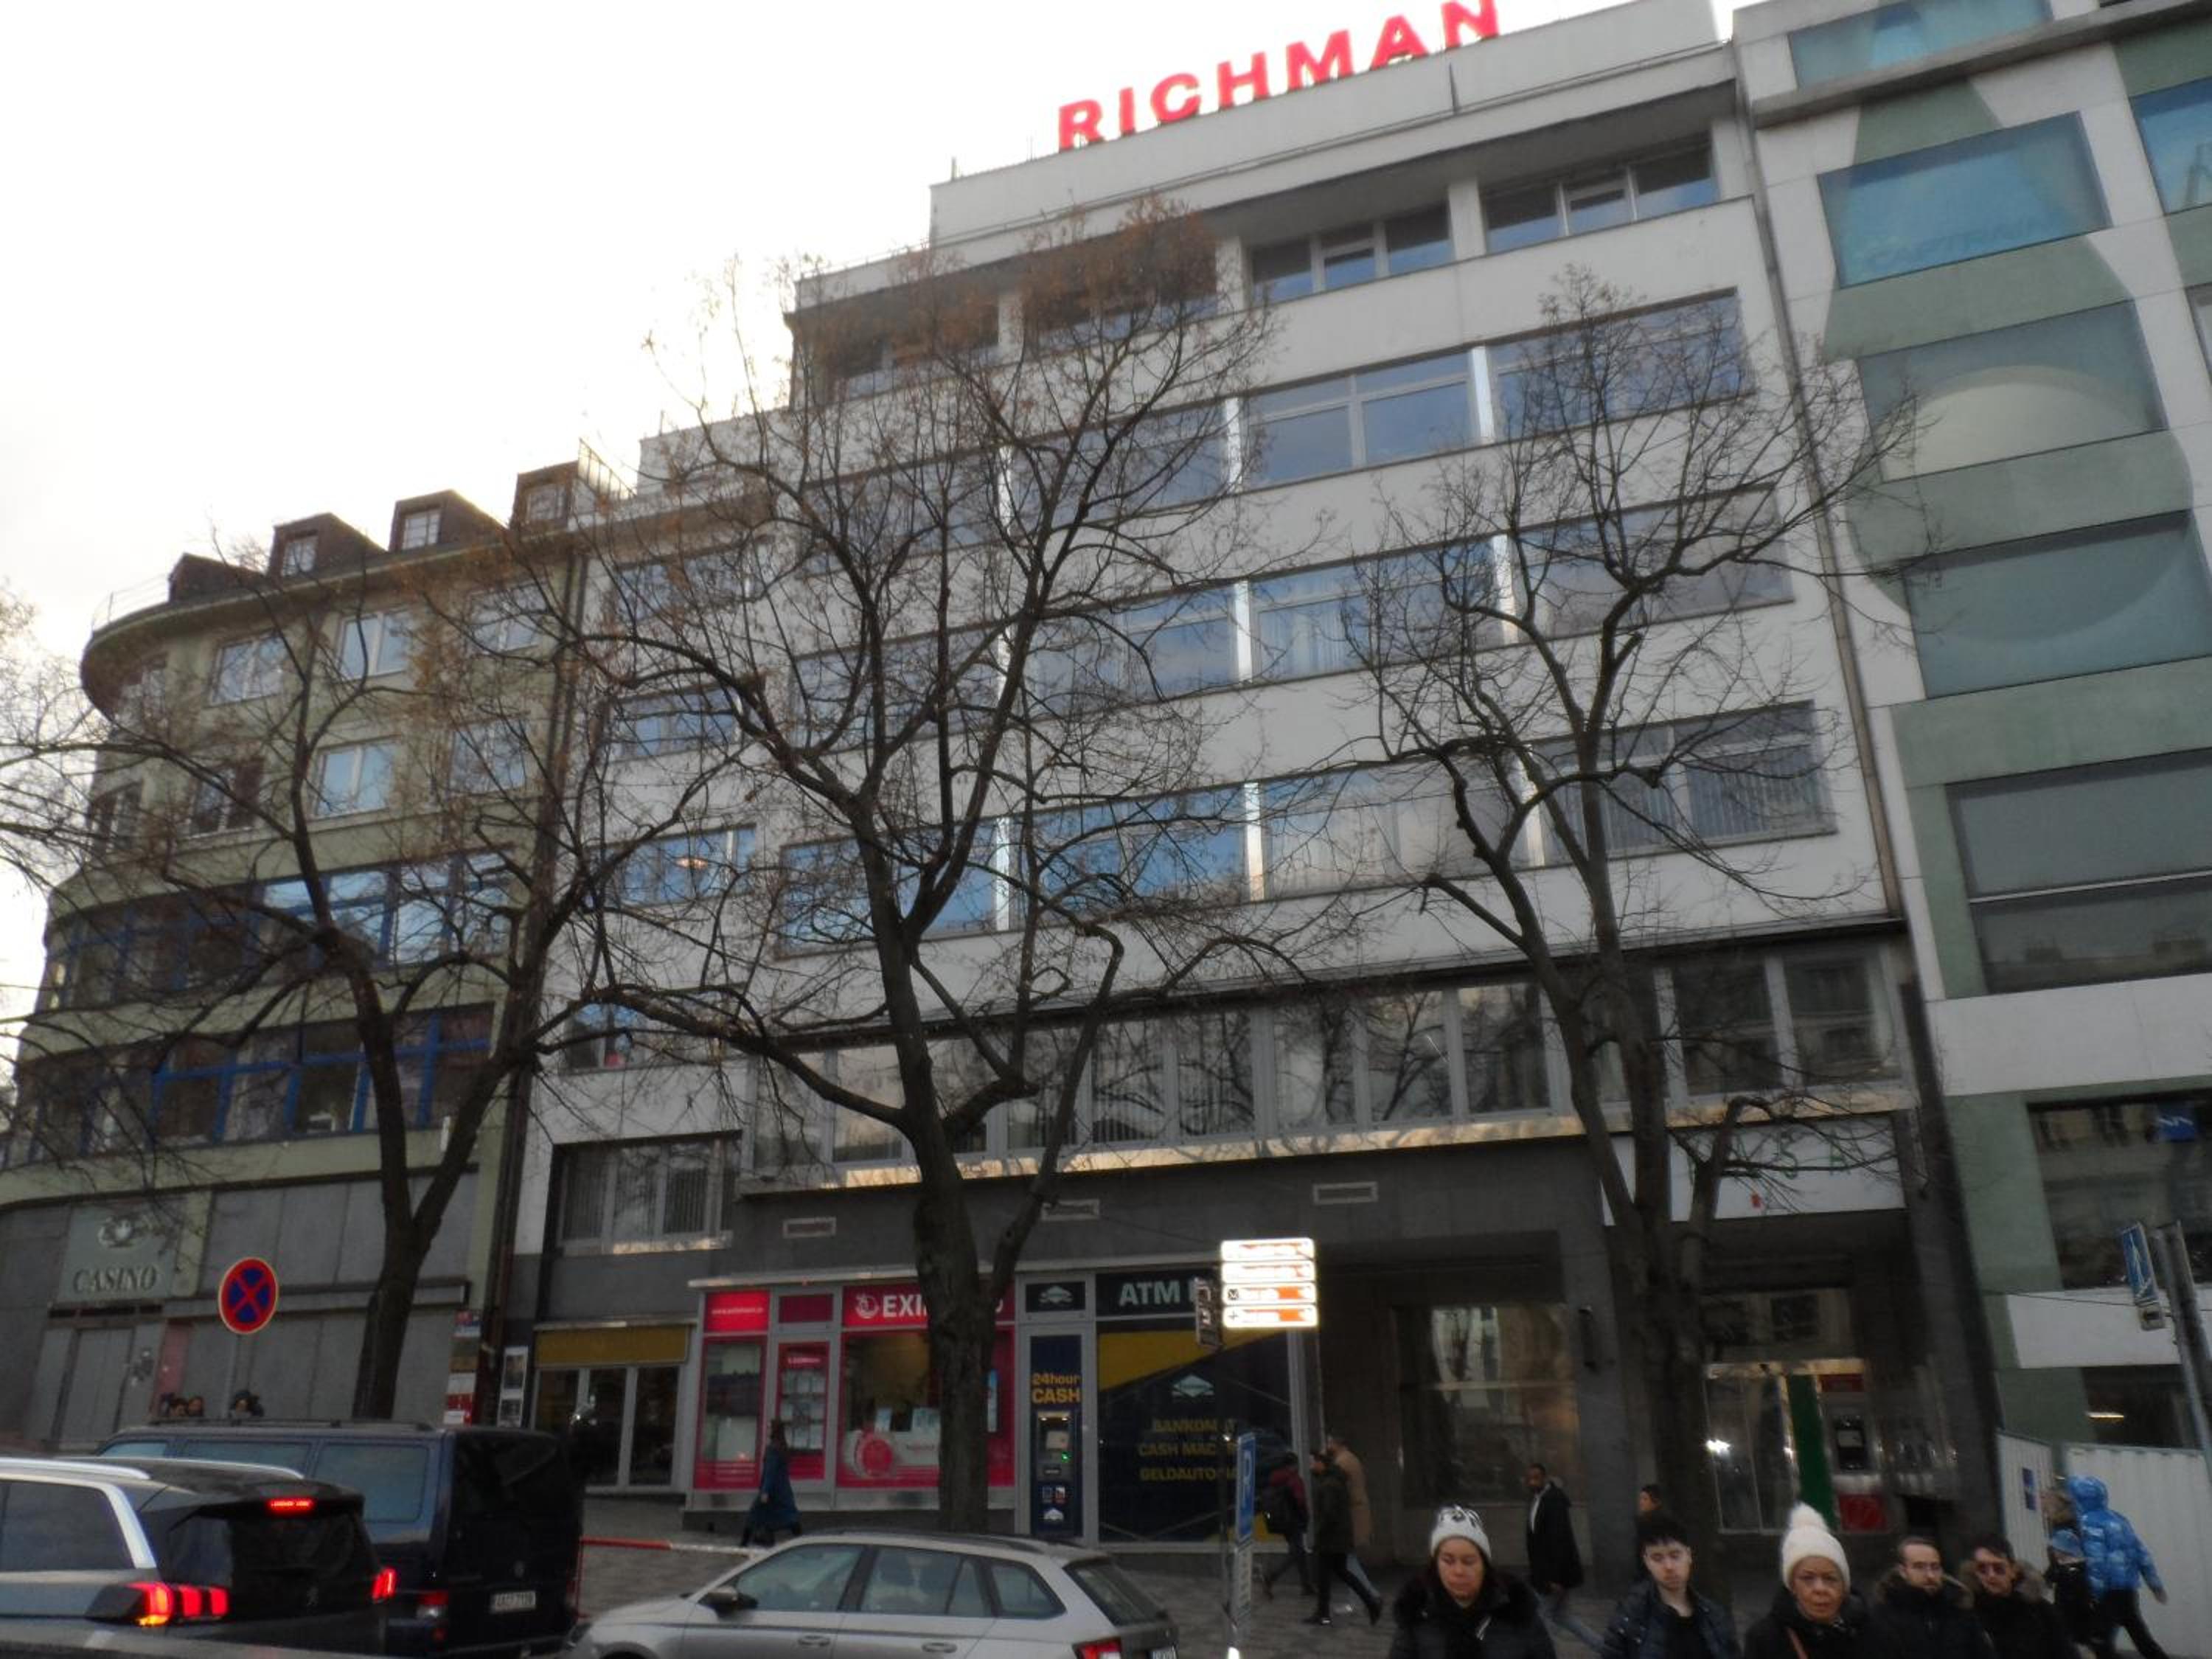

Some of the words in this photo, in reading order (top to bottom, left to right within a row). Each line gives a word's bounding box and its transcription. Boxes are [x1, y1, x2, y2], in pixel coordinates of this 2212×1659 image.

[1057, 0, 1500, 153] RICHMAN
[73, 1265, 156, 1293] CASINO
[1119, 1280, 1180, 1306] ATM
[1032, 1372, 1079, 1385] 24hour
[1032, 1388, 1080, 1404] CASH
[1153, 1419, 1236, 1433] BANKOMT
